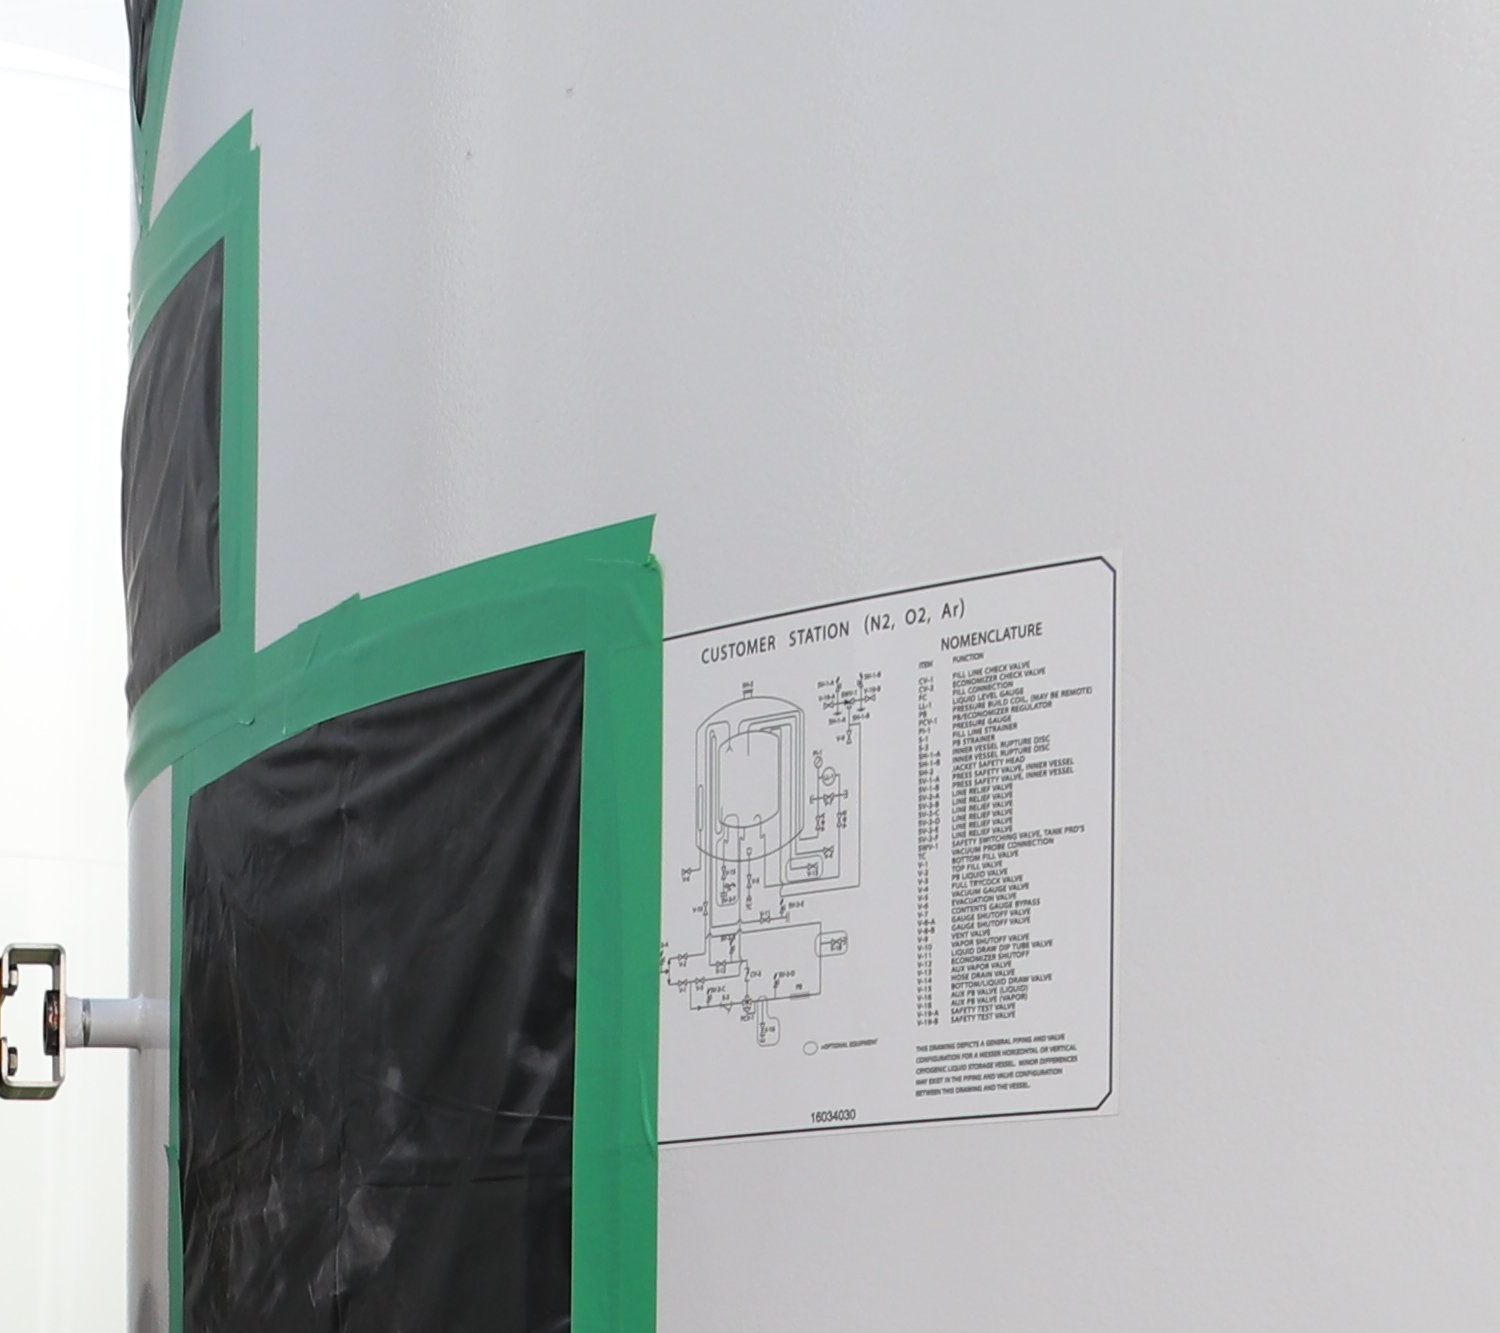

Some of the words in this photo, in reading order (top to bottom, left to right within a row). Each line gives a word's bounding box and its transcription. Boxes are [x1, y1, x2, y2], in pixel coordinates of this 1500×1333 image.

[701, 635, 775, 664] CUSTOMER
[789, 621, 849, 647] STATION
[864, 614, 895, 635] (N2,
[905, 608, 930, 625] O2,
[941, 601, 964, 619] Ar)
[941, 622, 1042, 651] NOMENCLATURE
[952, 652, 984, 663] FUNCTION
[952, 671, 966, 679] FILL
[967, 668, 982, 677] LINE
[984, 664, 1007, 674] CHECK
[1008, 661, 1030, 670] VALVE
[952, 674, 997, 687] ECONOMIZER
[999, 671, 1022, 681] CHECK
[1024, 667, 1045, 677] VALVE
[952, 688, 966, 696] FILL
[967, 681, 1013, 694] CONNECTION
[952, 694, 976, 704] LIQUID
[977, 691, 997, 701] LEVEL
[999, 687, 1024, 697] GAUGE
[952, 701, 985, 713] PRESSURE
[987, 698, 1008, 708] BUILD
[1050, 691, 1058, 699] BE
[1010, 700, 1052, 713] REGULATOR
[952, 718, 985, 729] PRESSURE
[987, 714, 1011, 725] GAUGE
[952, 730, 965, 738] FILL
[967, 727, 982, 736] LINE
[984, 722, 1017, 734] STRAINER
[952, 745, 972, 755] INNER
[974, 742, 998, 752] VESSEL
[1000, 737, 1031, 748] RUPTURE
[1033, 735, 1050, 744] DISC
[962, 733, 995, 745] STRAINER
[952, 761, 976, 772] JACKET
[978, 758, 1004, 768] SAFETY
[1005, 755, 1025, 764] HEAD
[952, 770, 972, 780] PRESS
[974, 767, 1000, 777] SAFETY
[1025, 761, 1047, 770] INNER
[1048, 758, 1074, 767] VESSEL
[952, 788, 966, 797] LINE
[968, 785, 990, 794] RELIEF
[992, 782, 1013, 791] VALVE
[951, 837, 977, 847] SAFETY
[951, 846, 981, 855] VACUUM
[982, 842, 1005, 851] PROBE
[1007, 837, 1054, 849] CONNECTION
[951, 903, 987, 914] CONTENTS
[988, 901, 1012, 910] GAUGE
[1014, 898, 1040, 907] BYPASS
[951, 947, 975, 957] LIQUID
[976, 945, 997, 954] DRAW
[1012, 941, 1029, 950] TUBE
[1031, 939, 1052, 947] VALVE
[1008, 976, 1029, 984] DRAW
[1030, 973, 1052, 982] VALVE
[950, 1014, 976, 1023] SAFETY
[976, 1012, 994, 1021] TEST
[994, 1010, 1015, 1019] VALVE
[810, 1108, 856, 1123] 16034030
